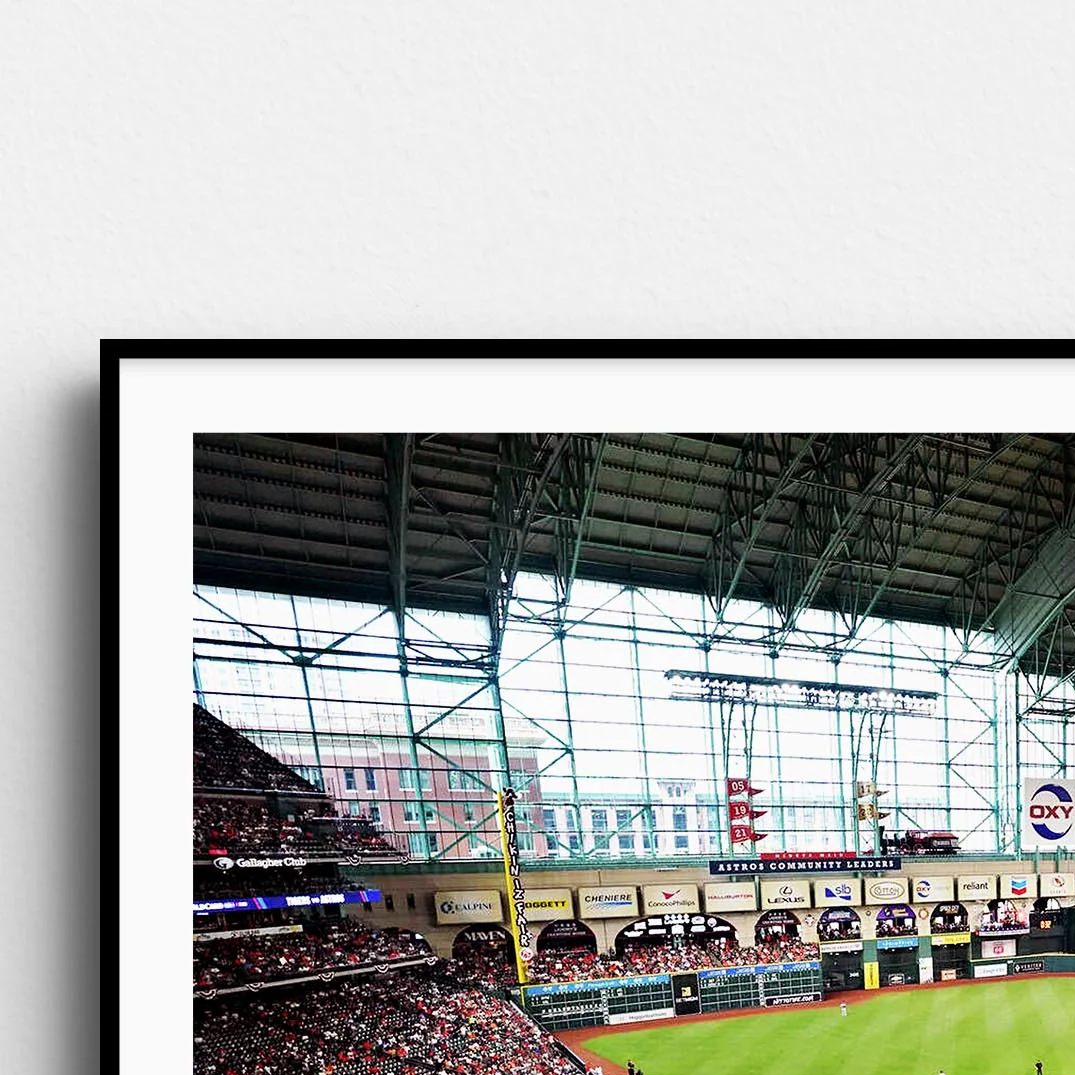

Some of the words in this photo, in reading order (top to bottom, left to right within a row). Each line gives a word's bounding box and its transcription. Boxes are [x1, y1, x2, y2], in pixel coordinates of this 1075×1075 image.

[731, 781, 745, 792] 05
[734, 806, 748, 816] 19
[1029, 805, 1074, 819] OXY
[734, 828, 748, 838] 21
[505, 811, 520, 877] CHIKIN
[236, 858, 284, 869] Gallagher
[284, 857, 307, 867] Club
[718, 863, 765, 872] ASTROS
[769, 861, 842, 871] COMMUNITY
[846, 860, 894, 869] LEADERS
[513, 878, 525, 900] IZ
[835, 885, 852, 895] slb
[963, 882, 988, 890] reliant
[585, 894, 632, 903] CHENIERE
[648, 900, 696, 908] ConocoPhillips
[524, 901, 566, 909] OGGETT
[515, 903, 531, 947] FAIR
[464, 931, 506, 942] MAVEN
